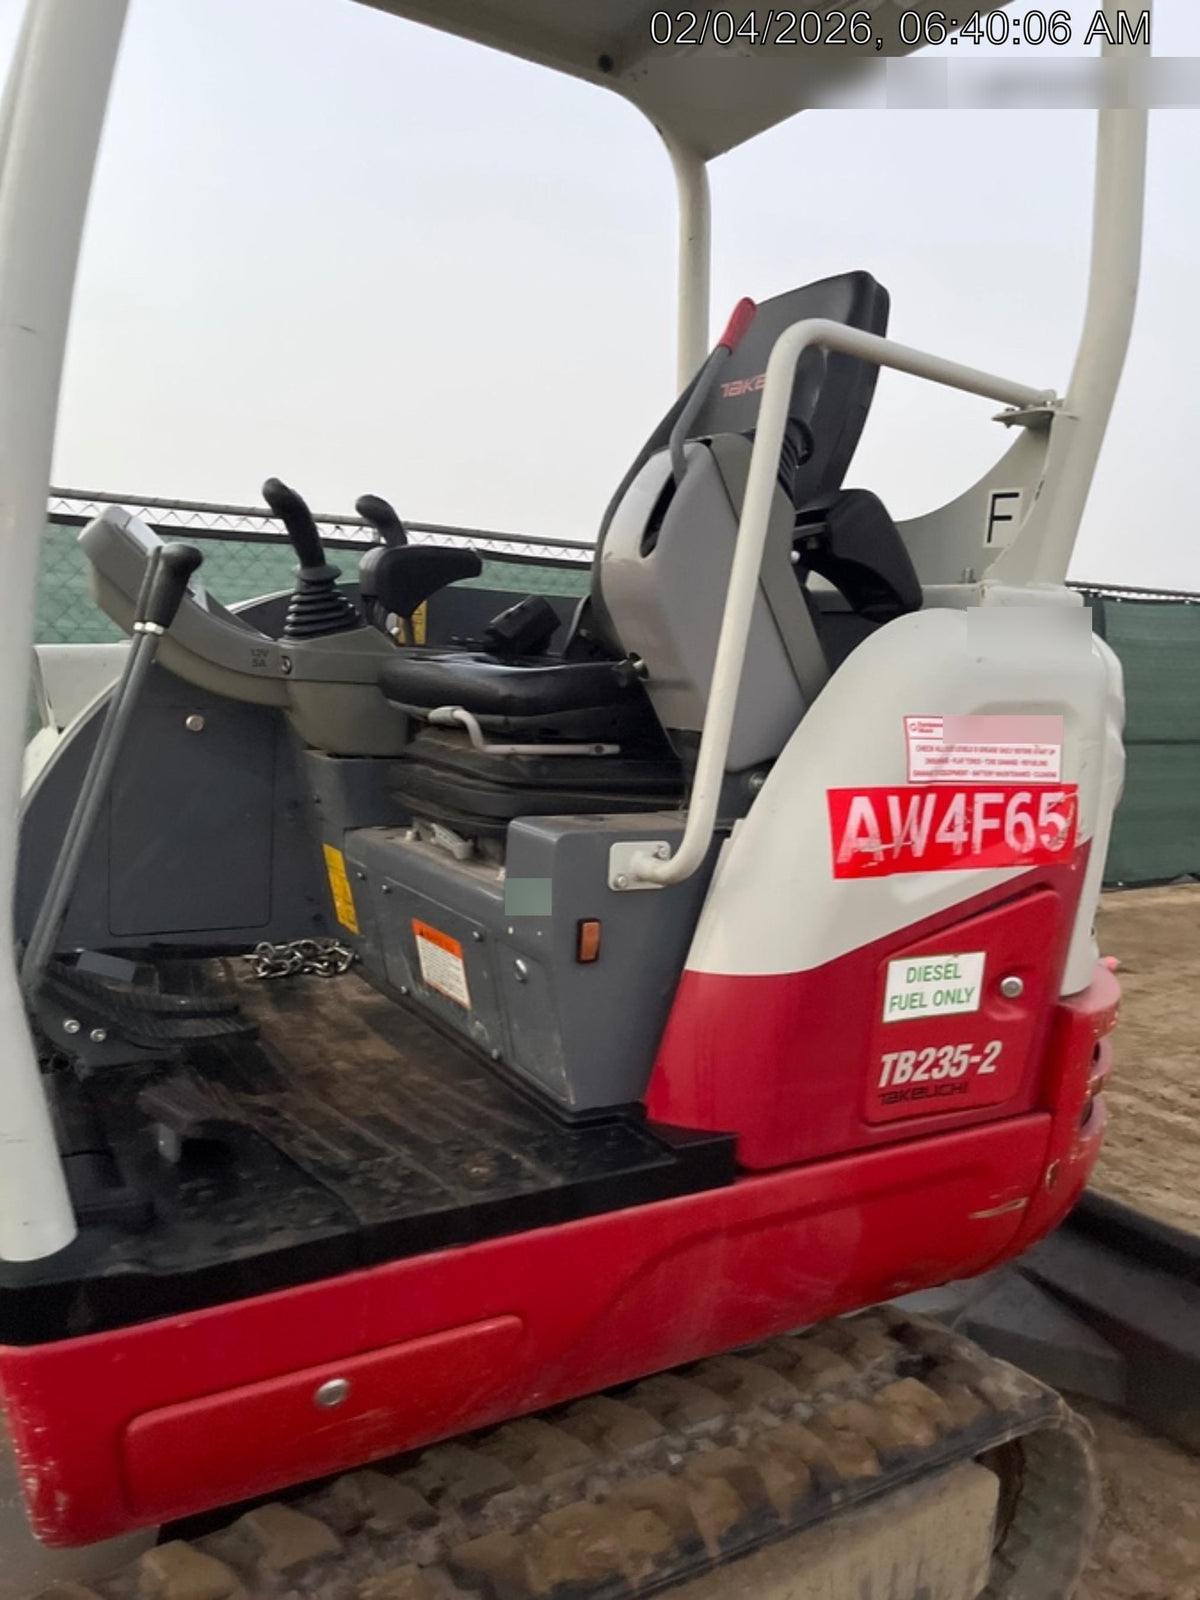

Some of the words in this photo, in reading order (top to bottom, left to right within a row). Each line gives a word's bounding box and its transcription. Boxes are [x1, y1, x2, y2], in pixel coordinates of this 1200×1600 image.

[987, 492, 1020, 543] F
[836, 791, 1070, 863] AW4F65
[906, 963, 962, 983] DIESEL
[889, 992, 928, 1012] FUEL
[933, 987, 976, 1007] ONLY
[878, 1040, 1003, 1088] TB235-2
